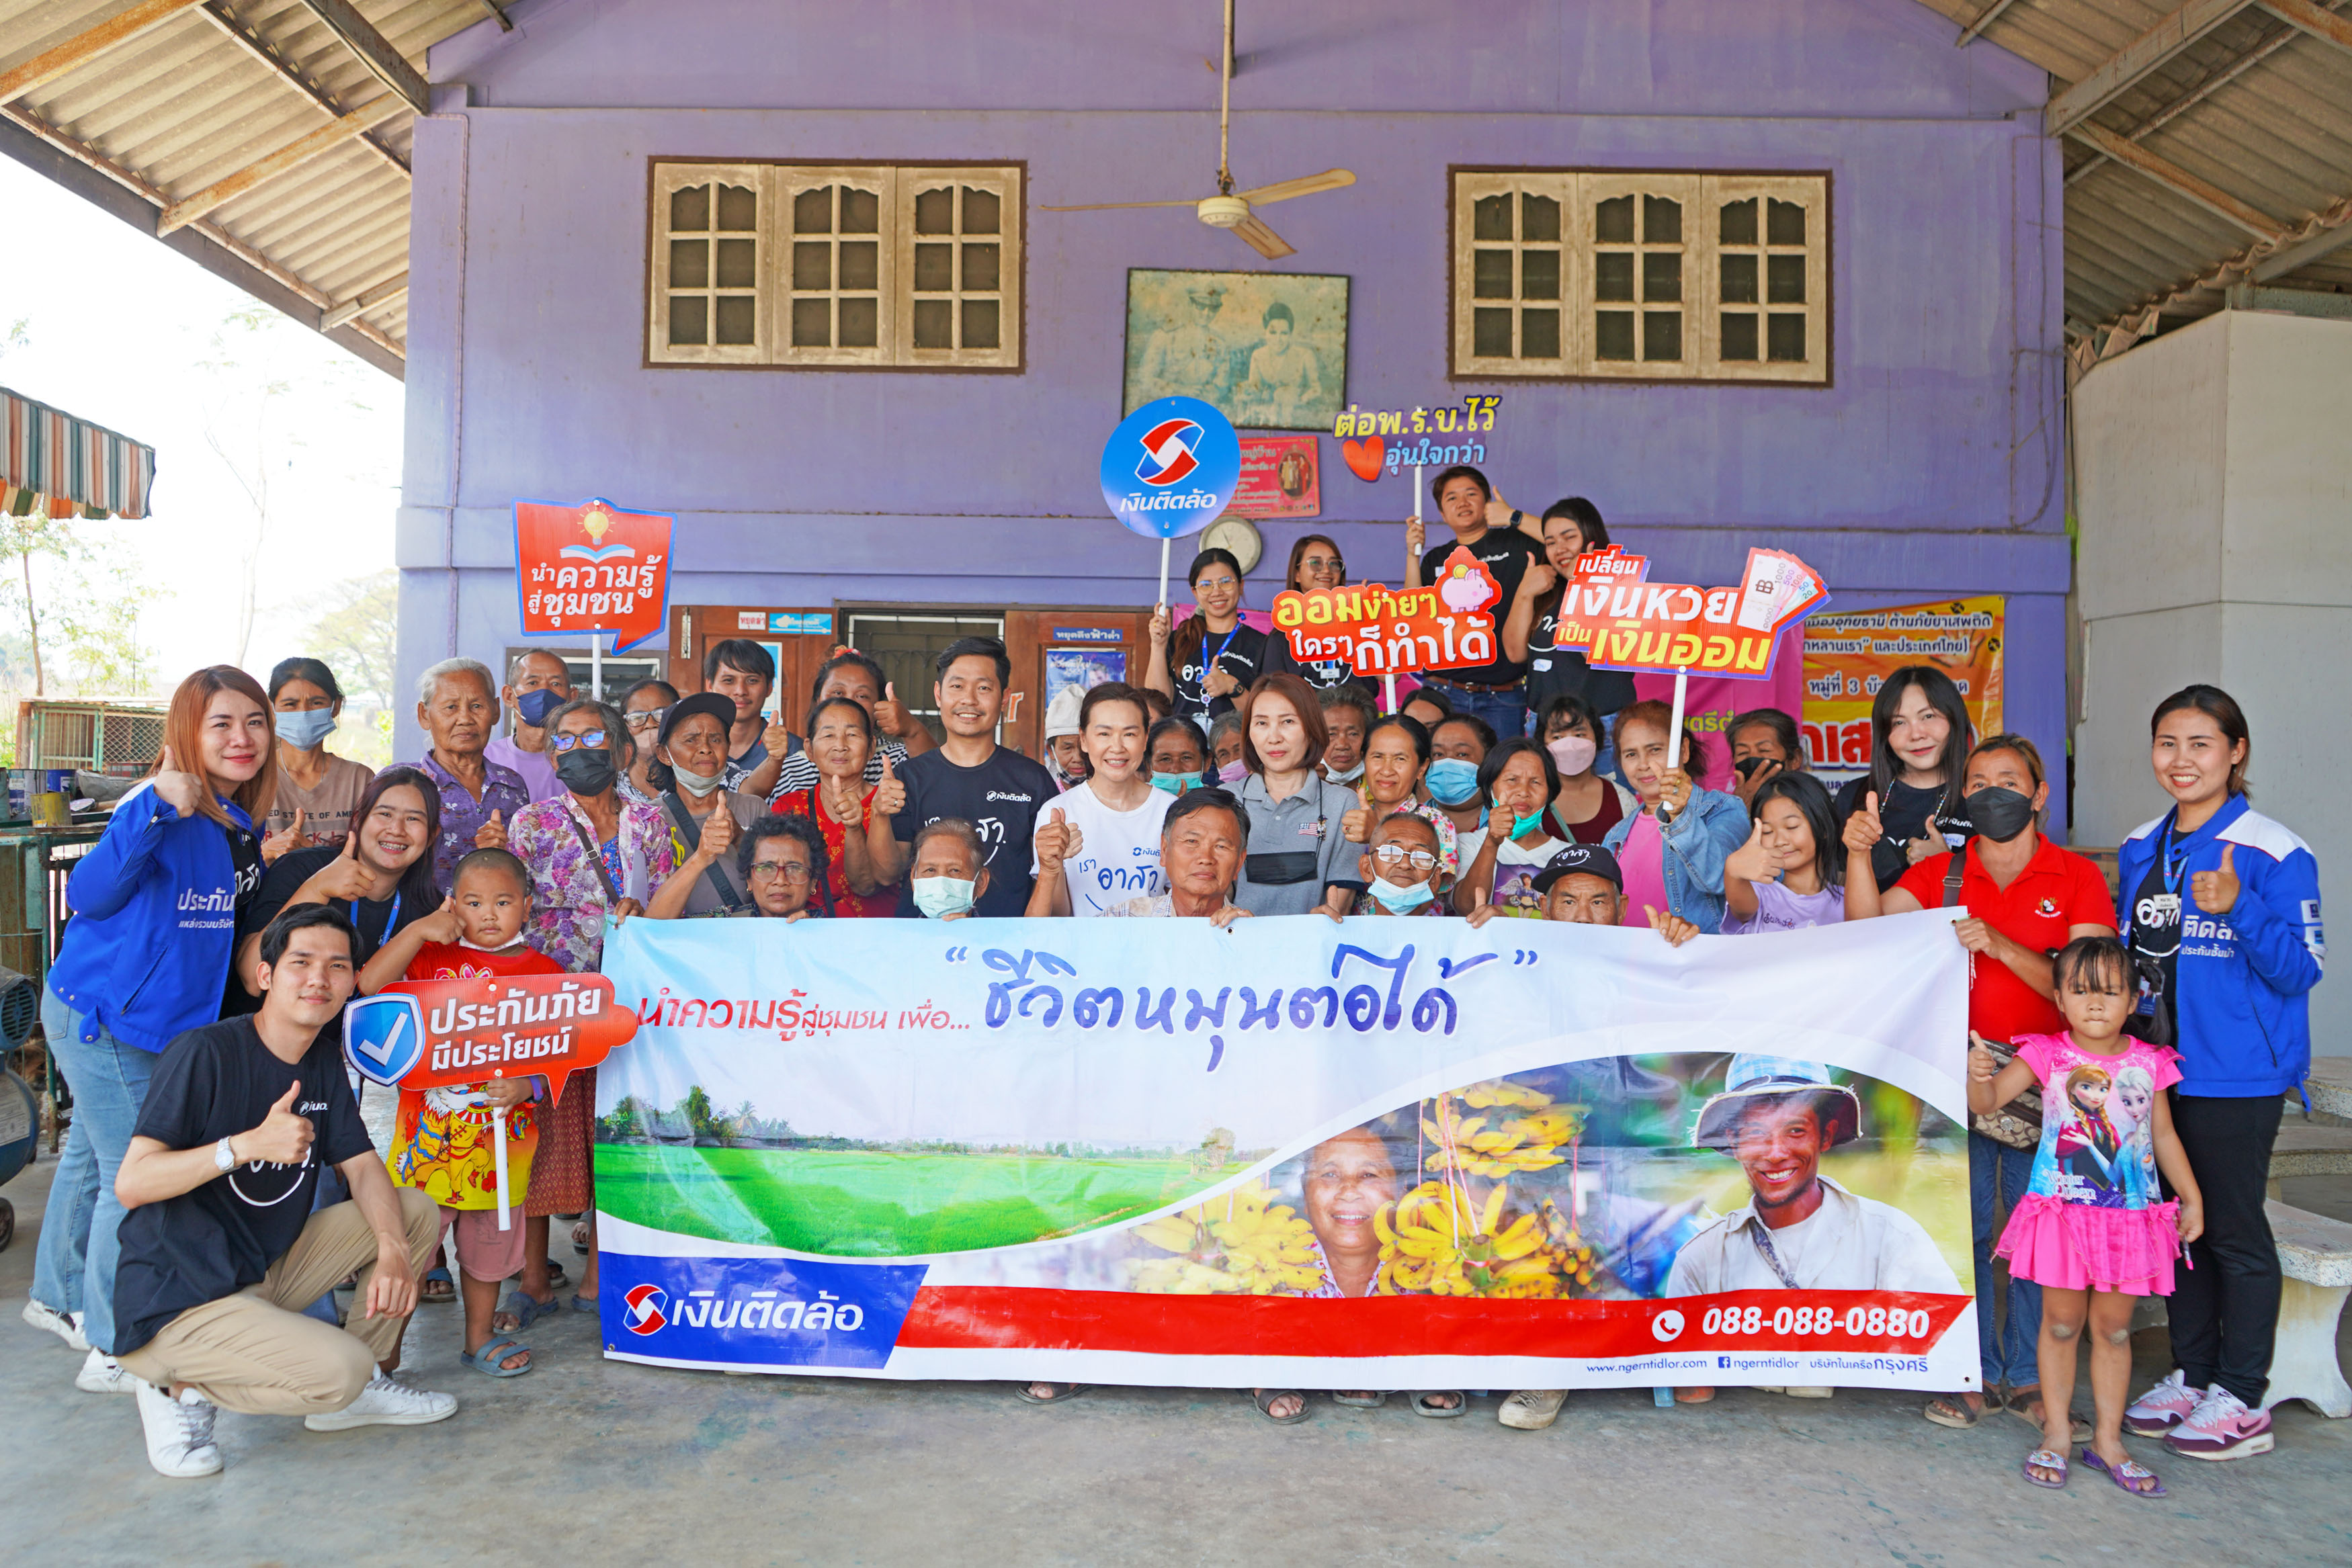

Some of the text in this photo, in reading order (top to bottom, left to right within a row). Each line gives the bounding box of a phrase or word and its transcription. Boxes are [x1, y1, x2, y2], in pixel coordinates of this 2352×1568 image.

[1386, 438, 1484, 472] อุ่นใจกว่า
[1120, 488, 1217, 513] เงินติดล้อ
[532, 554, 663, 598] นำความรู้
[1579, 549, 1638, 576] เปลี่ยน
[1564, 576, 1738, 625] เงินหวย
[1799, 581, 1809, 592] 50
[1802, 590, 1813, 599] 20
[528, 589, 634, 627] สู่ชุมชน
[1277, 591, 1437, 626] ออมง่ายๆ
[1849, 679, 1859, 693] 3
[1079, 859, 1096, 873] เรา
[1142, 848, 1161, 857] เงินติ
[430, 982, 601, 1035] ประกันภัย
[431, 1026, 573, 1071] มีประโยชน์
[672, 1290, 864, 1332] เงินติดล้อ
[1702, 1306, 1930, 1339] 088-088-0880
[1586, 1357, 1708, 1373] www.ngerntidlor.com
[1734, 1356, 1799, 1372] ngerntidlor
